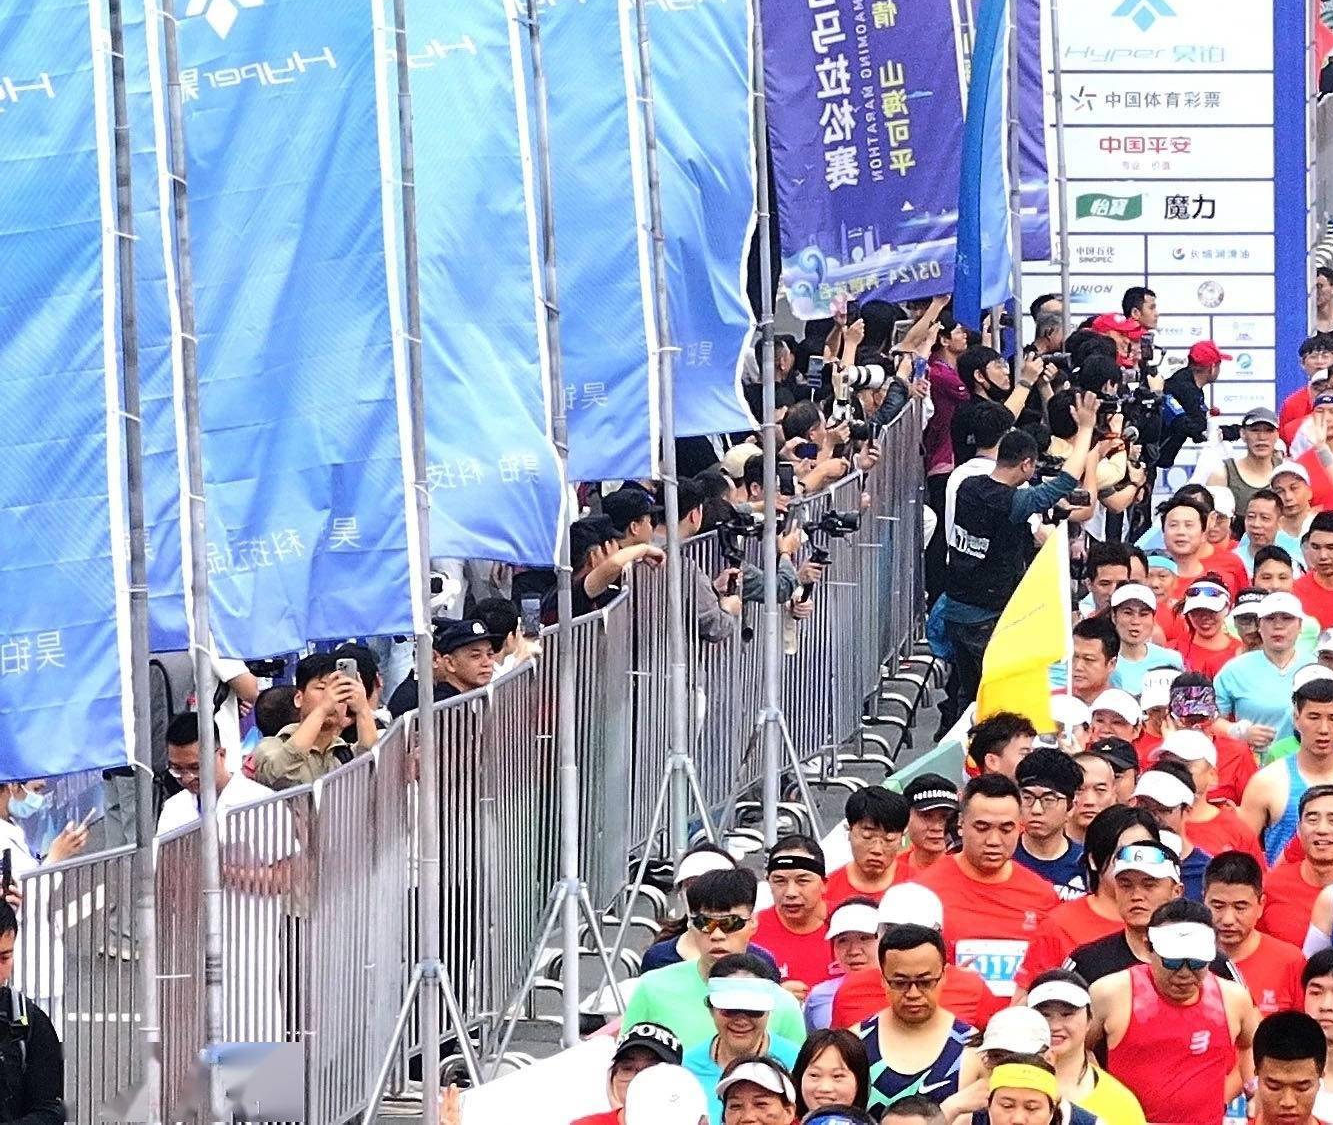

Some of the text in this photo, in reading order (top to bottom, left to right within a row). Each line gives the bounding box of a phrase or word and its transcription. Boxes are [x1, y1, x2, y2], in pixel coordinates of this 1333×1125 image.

[1064, 44, 1167, 63] Hyper
[1105, 91, 1222, 109] 中国体育彩票
[1100, 136, 1192, 154] 中国平安
[1164, 194, 1217, 220] 魔力
[1078, 256, 1113, 264] SINOPEC
[1069, 284, 1113, 294] UNION
